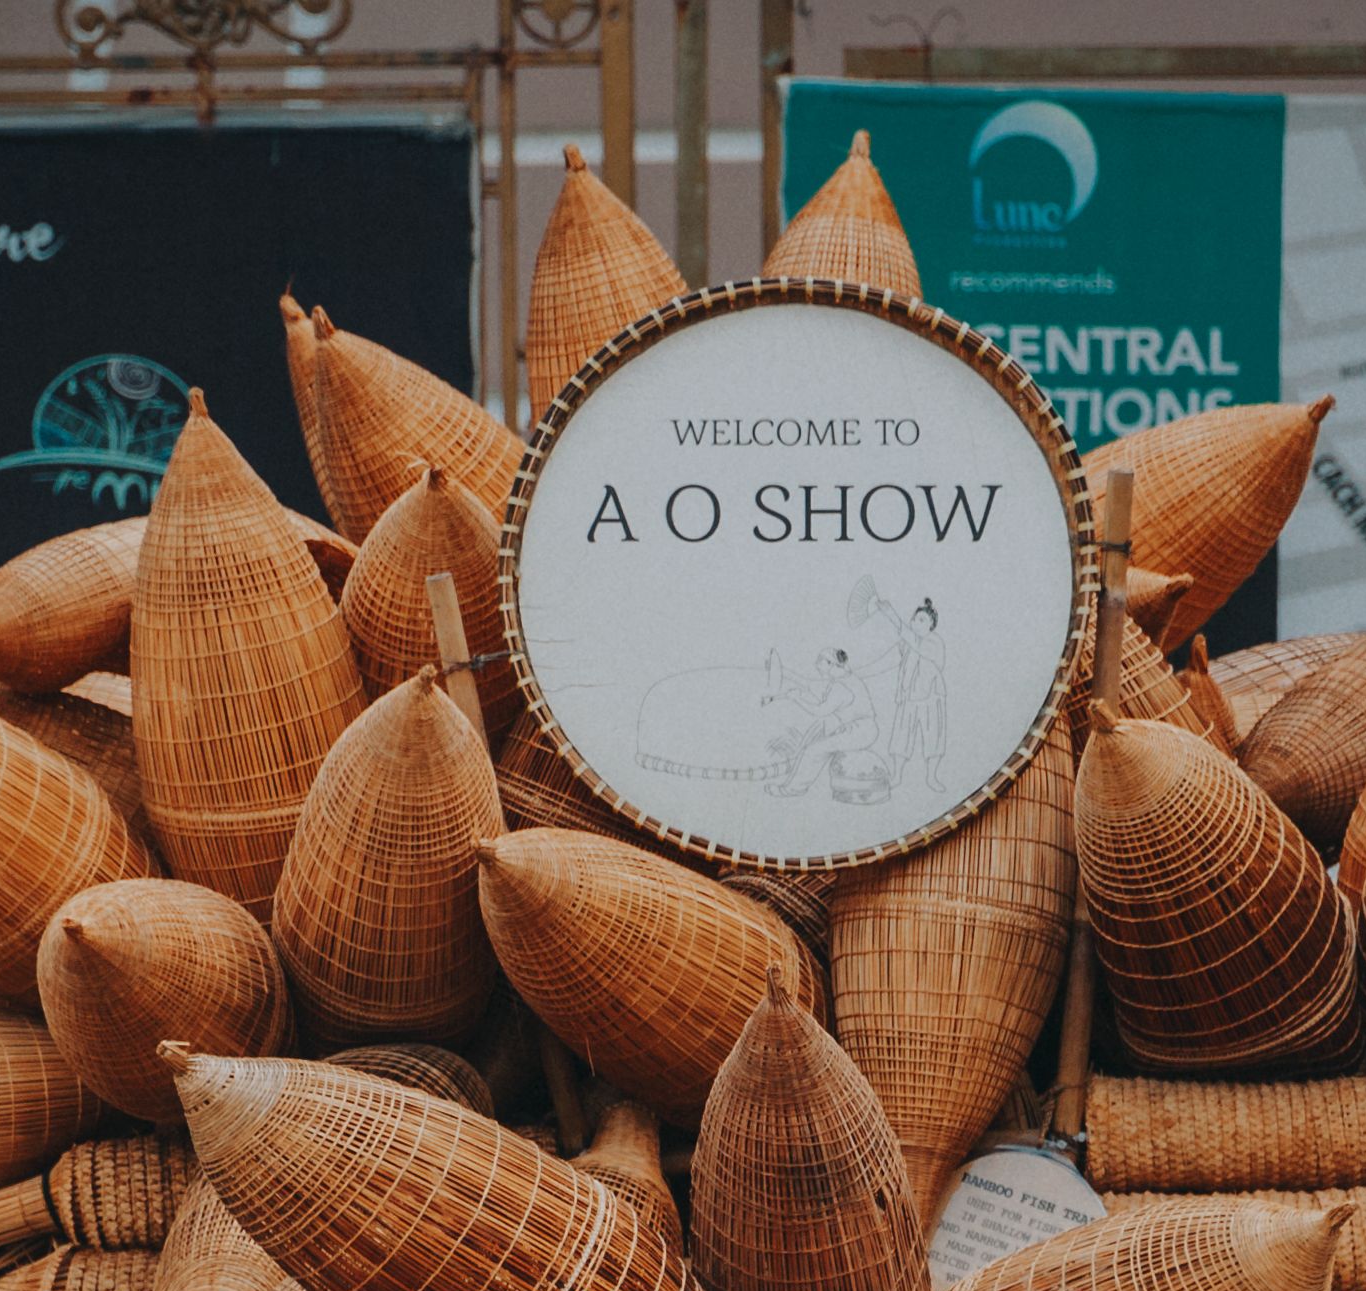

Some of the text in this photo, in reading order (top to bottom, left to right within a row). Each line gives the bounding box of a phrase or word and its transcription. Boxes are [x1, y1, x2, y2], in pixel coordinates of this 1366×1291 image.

[949, 266, 1117, 295] recommends
[671, 418, 921, 447] WELCOME TO
[1313, 454, 1366, 518] CACH
[586, 484, 1002, 543] A O SHOW
[962, 1172, 1013, 1198] BAMBOO
[1020, 1192, 1056, 1213] FISH
[961, 1210, 1032, 1242] IN SHALLOW
[1000, 1206, 1023, 1223] FOR
[938, 1220, 1007, 1251] AND NARROW
[946, 1239, 977, 1257] MADE
